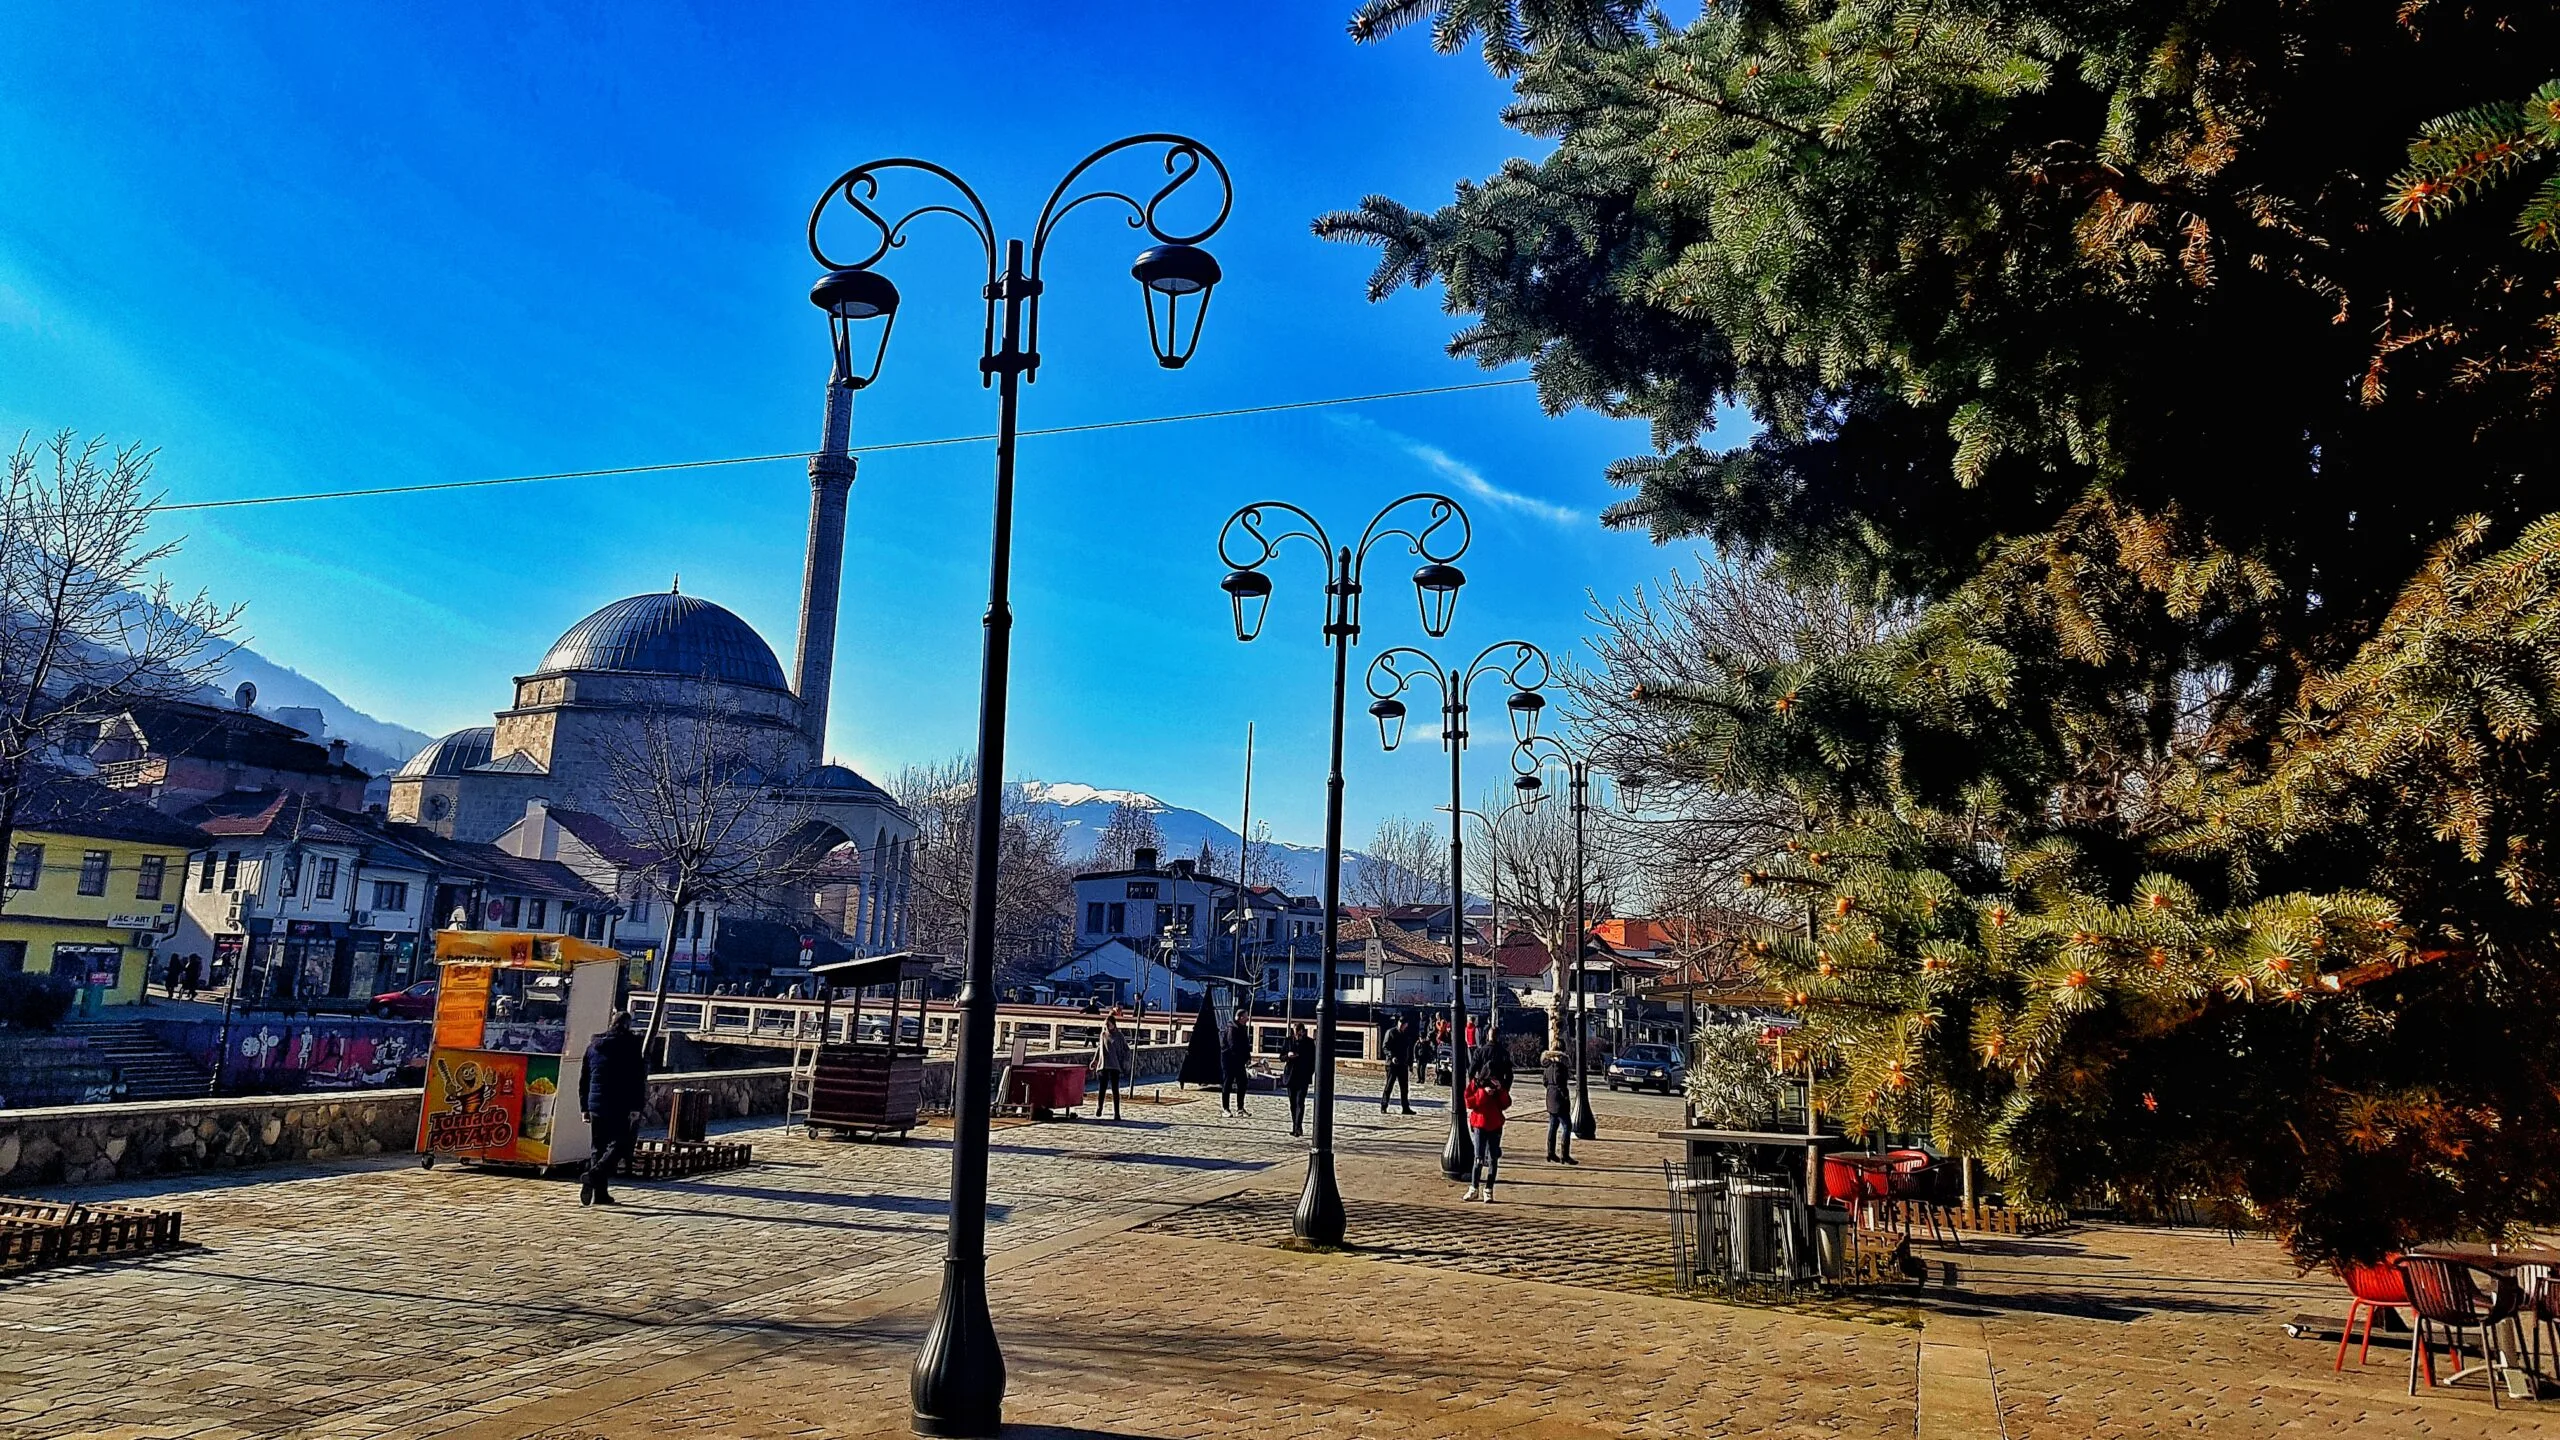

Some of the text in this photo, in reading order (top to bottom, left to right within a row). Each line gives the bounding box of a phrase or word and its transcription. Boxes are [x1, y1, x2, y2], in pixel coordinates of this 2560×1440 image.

[134, 915, 151, 923] ART
[430, 1106, 509, 1131] Tornado
[428, 1123, 513, 1150] POTATO
